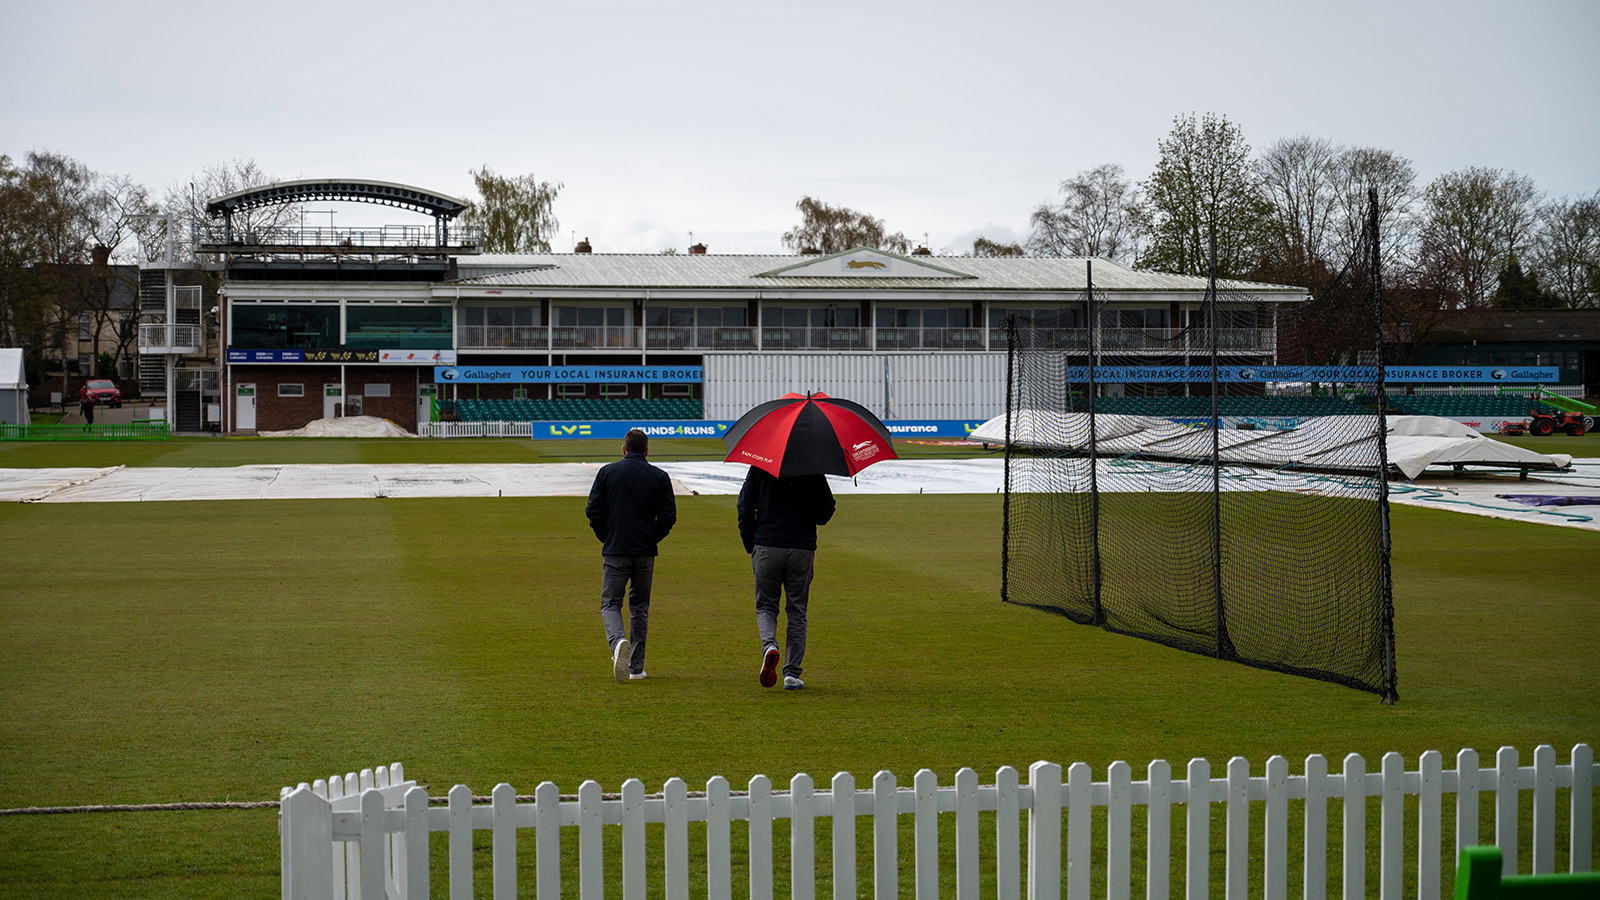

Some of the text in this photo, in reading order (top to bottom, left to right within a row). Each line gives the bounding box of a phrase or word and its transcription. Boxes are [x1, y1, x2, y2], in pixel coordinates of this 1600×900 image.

[464, 370, 511, 380] Gallagher
[521, 370, 703, 378] YOUR LOCAL INSURANCE BROKE
[1094, 370, 1121, 378] OCAL
[1125, 370, 1185, 378] INSURANCE
[1190, 370, 1231, 378] BROER
[1313, 370, 1483, 378] YOUR LOCAL NSURANCE BROKER
[1511, 370, 1554, 380] Gallagher
[886, 425, 938, 433] nsurance
